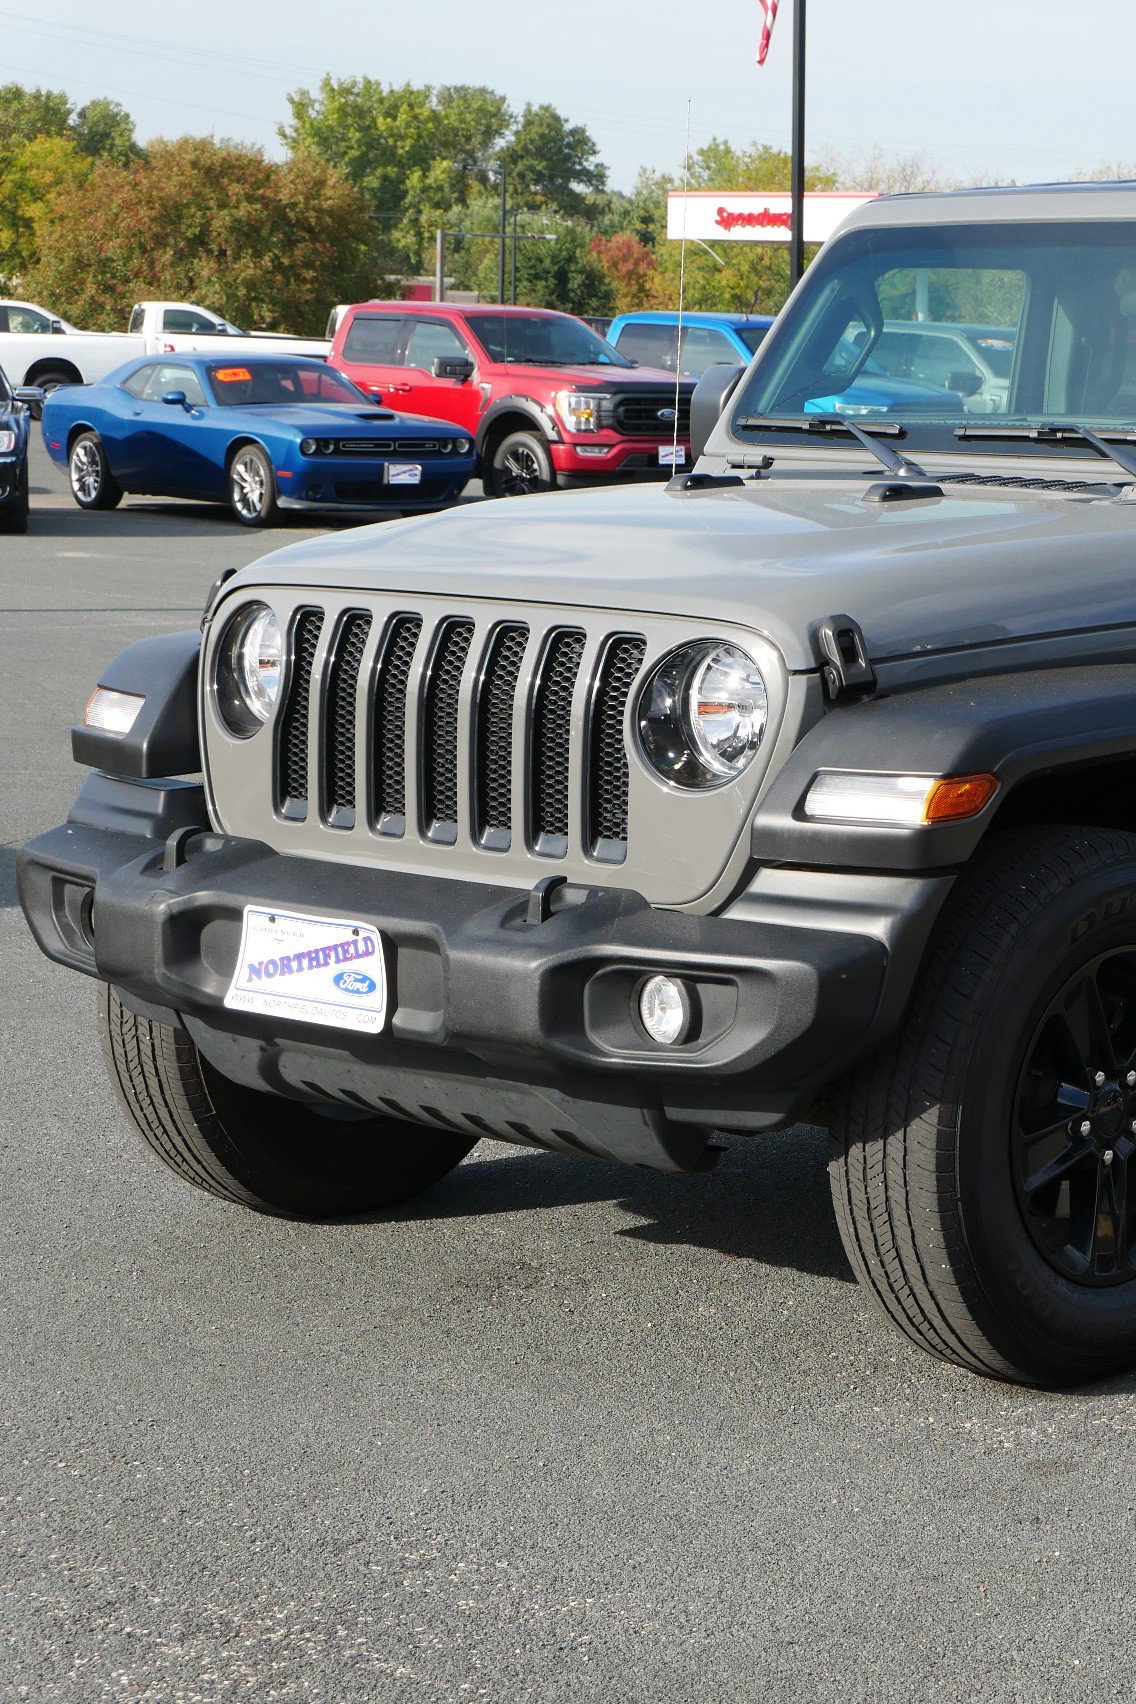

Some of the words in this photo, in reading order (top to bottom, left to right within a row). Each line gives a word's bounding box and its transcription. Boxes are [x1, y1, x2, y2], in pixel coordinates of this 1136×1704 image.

[714, 206, 792, 232] Speedwa
[246, 935, 376, 983] NORTHFIELD
[339, 971, 370, 993] Ford
